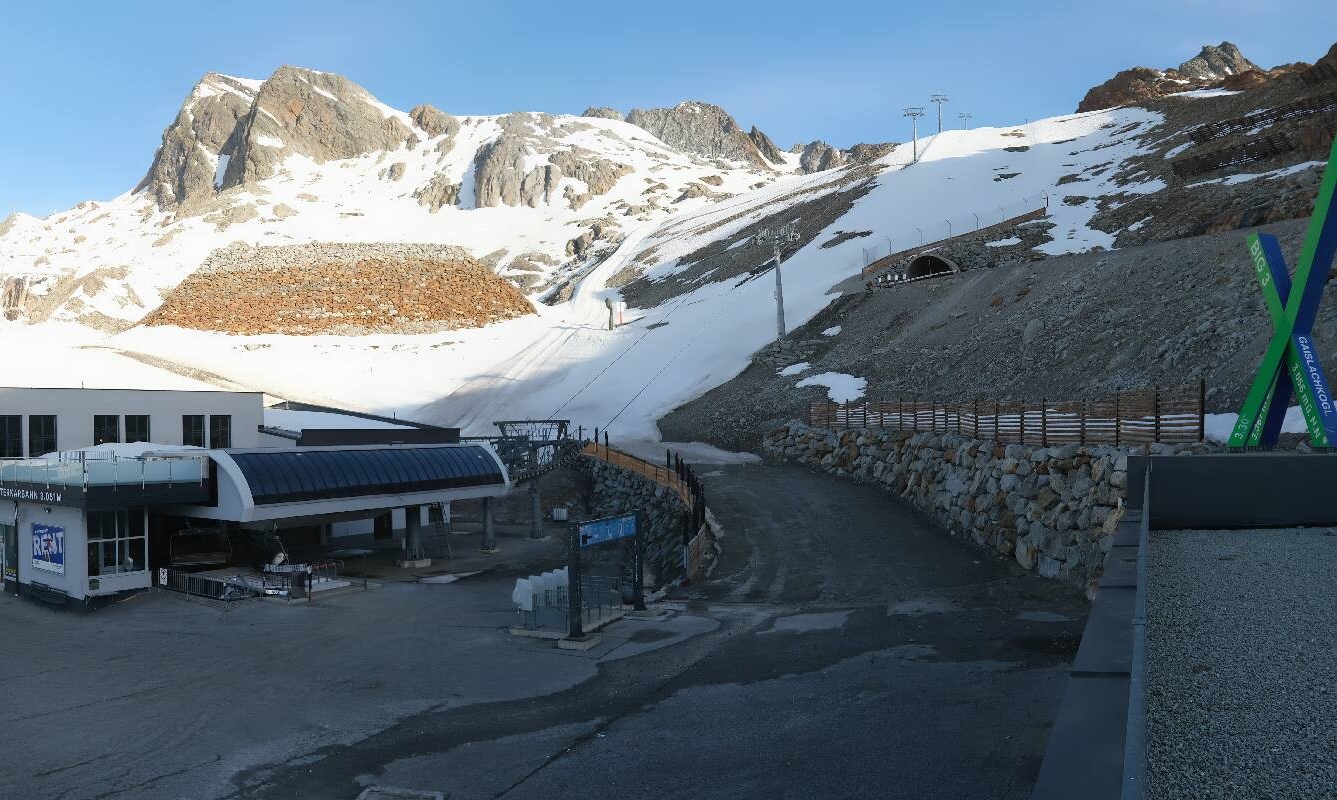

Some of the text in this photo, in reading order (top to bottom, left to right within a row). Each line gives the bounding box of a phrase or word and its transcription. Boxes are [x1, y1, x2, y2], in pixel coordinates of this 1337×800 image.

[1251, 240, 1270, 286] BIG 3
[1298, 336, 1333, 416] GAISLACHKOGL
[32, 531, 64, 556] RENT
